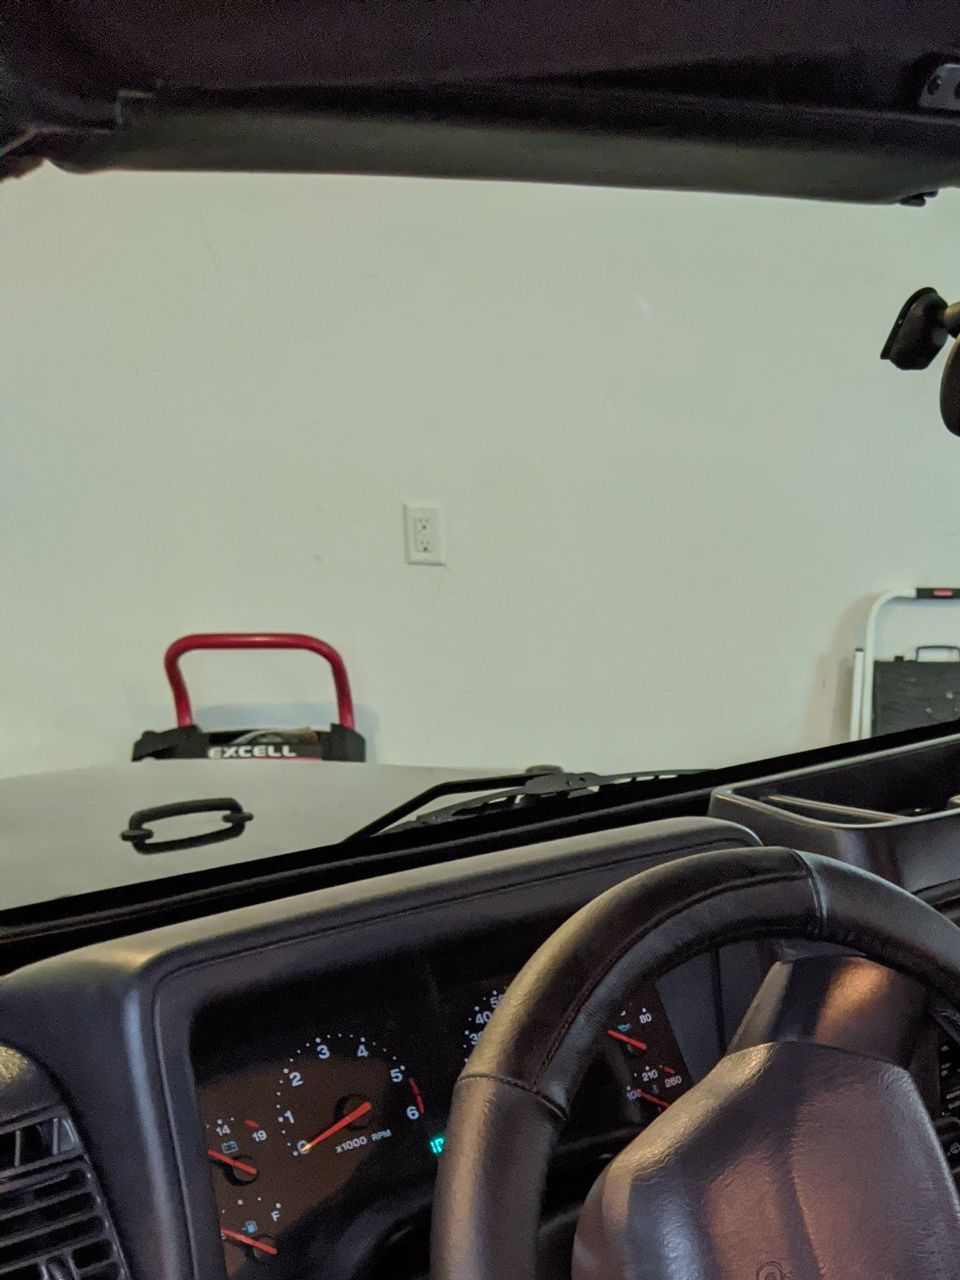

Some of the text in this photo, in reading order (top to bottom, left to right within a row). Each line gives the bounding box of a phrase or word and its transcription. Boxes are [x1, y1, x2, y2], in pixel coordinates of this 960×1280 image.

[208, 745, 297, 759] EXCELL
[475, 1011, 492, 1024] 40
[640, 1013, 652, 1024] 80
[317, 1045, 330, 1059] 3
[357, 1044, 369, 1058] 4
[289, 1072, 303, 1087] 2
[390, 1068, 403, 1083] 5
[642, 1070, 658, 1082] 210
[284, 1110, 294, 1124] 1
[406, 1105, 419, 1120] 6
[216, 1125, 231, 1136] 14
[252, 1130, 267, 1142] 19
[336, 1129, 392, 1153] x1000 RPM
[271, 1210, 280, 1222] F
